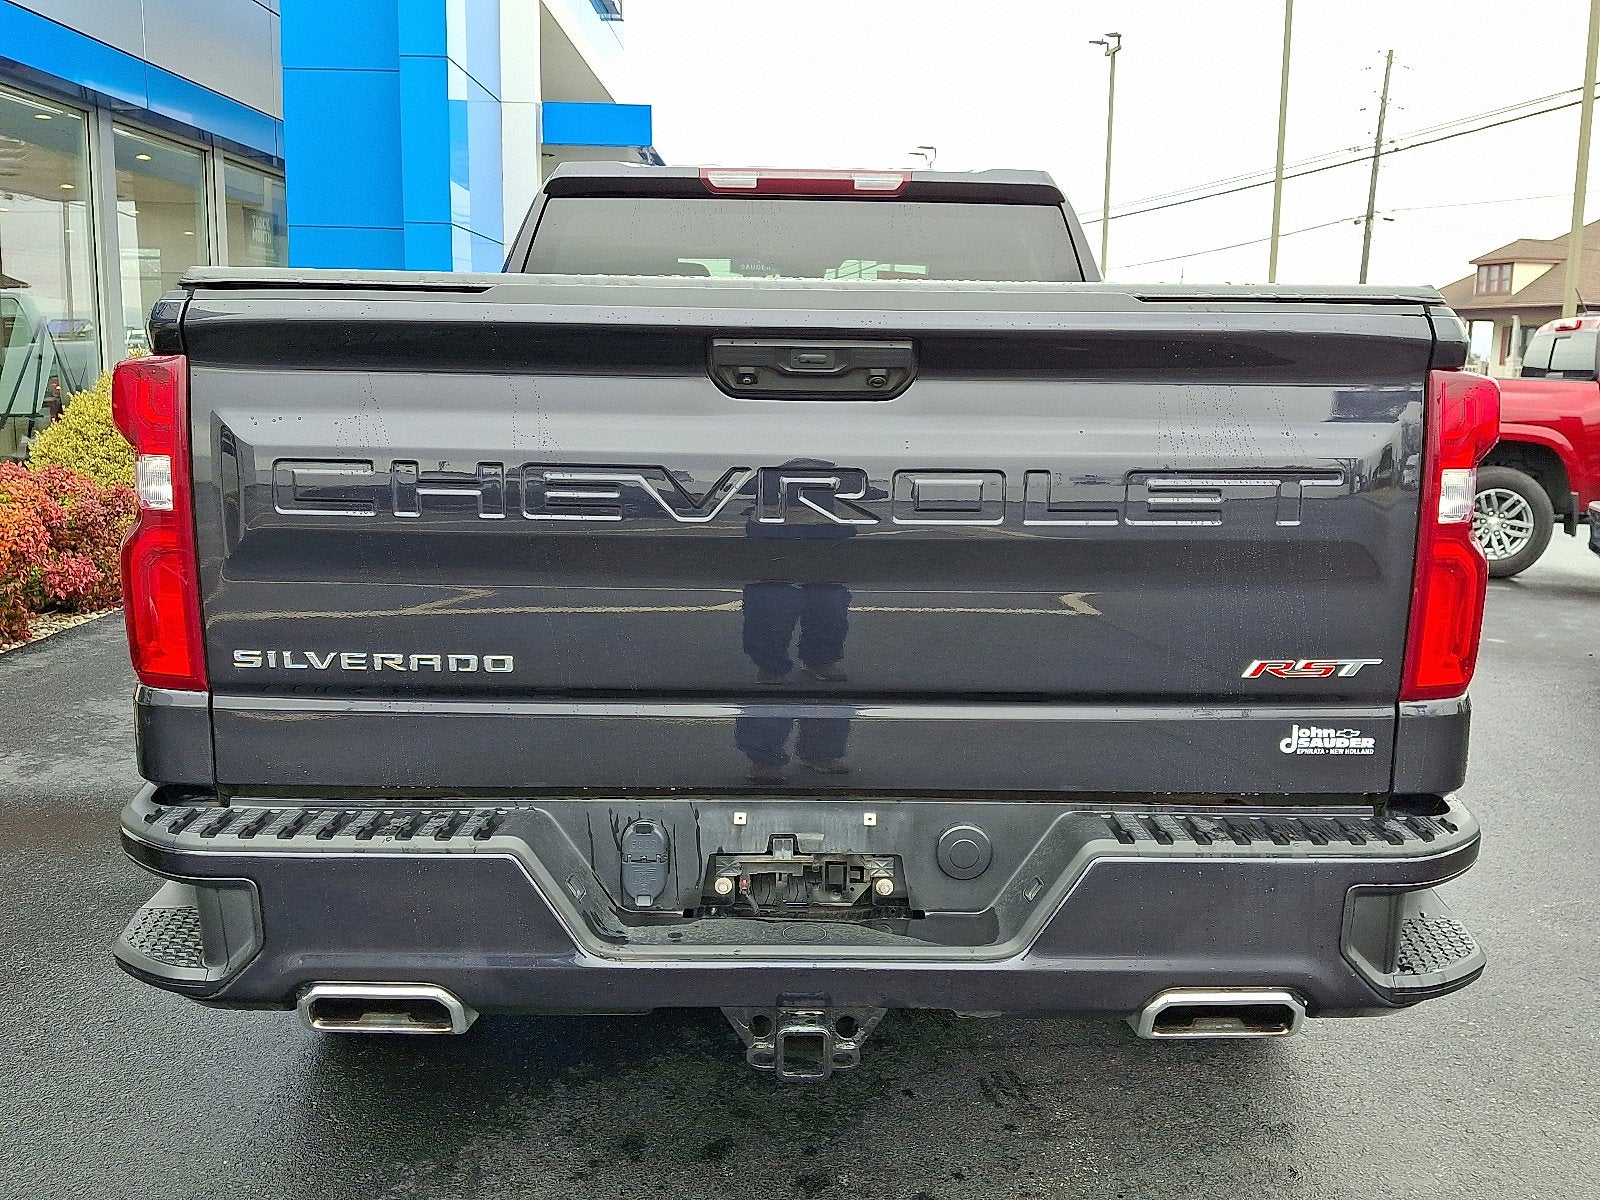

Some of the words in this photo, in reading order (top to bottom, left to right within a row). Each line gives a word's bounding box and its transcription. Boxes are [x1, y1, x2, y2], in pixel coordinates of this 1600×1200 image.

[272, 458, 1345, 527] CHEVROLET
[233, 650, 514, 673] SILVERADO
[1241, 658, 1383, 679] RST
[1280, 724, 1336, 754] John
[1298, 737, 1376, 748] SAUDER
